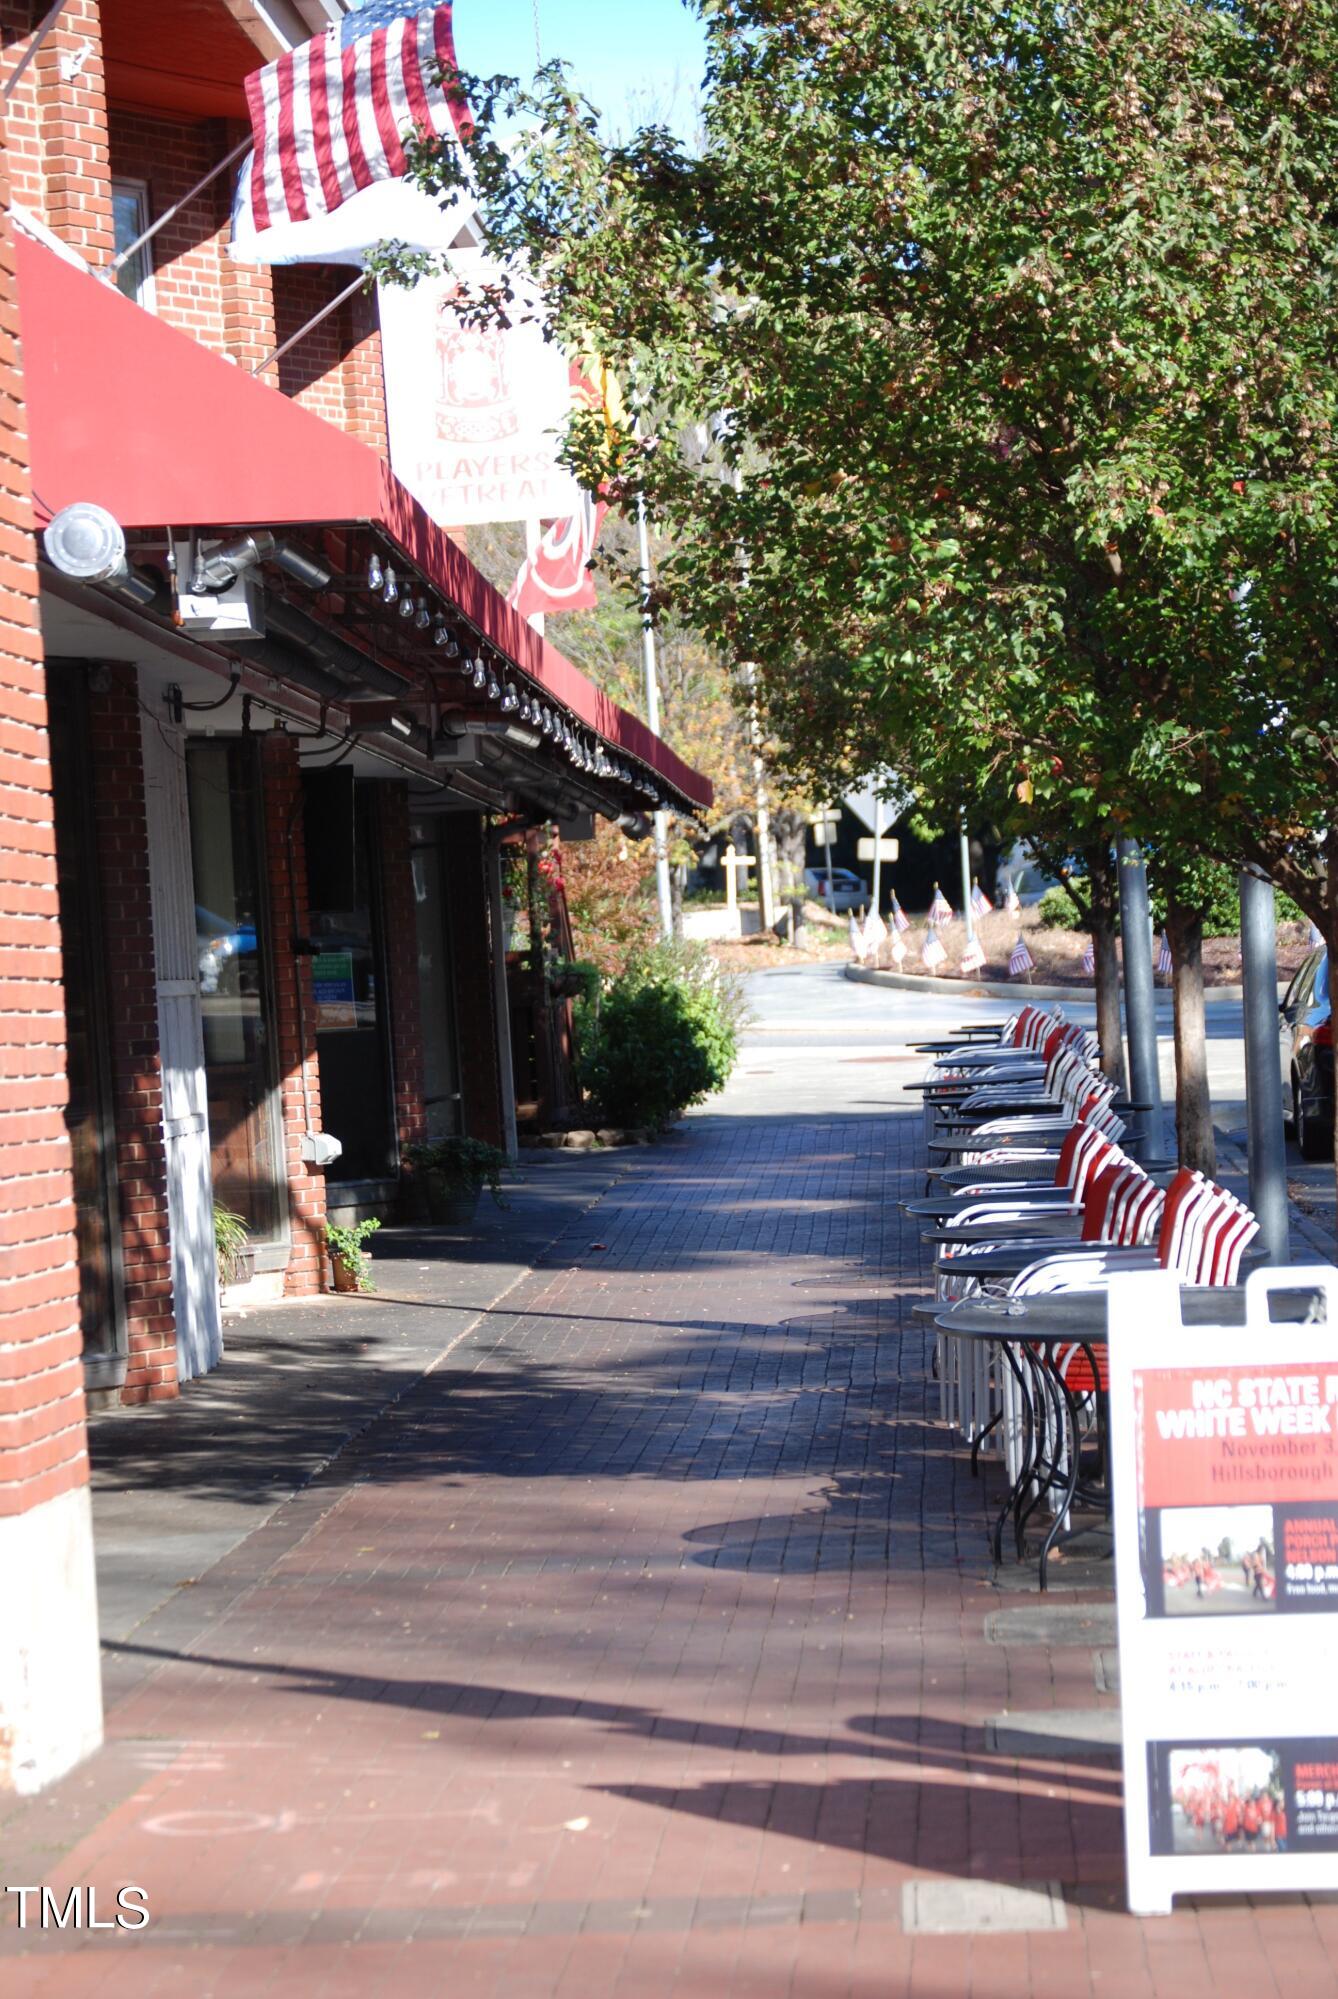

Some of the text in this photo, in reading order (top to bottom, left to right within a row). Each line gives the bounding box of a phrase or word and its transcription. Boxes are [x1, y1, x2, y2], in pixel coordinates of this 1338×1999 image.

[416, 452, 550, 481] PLAYERS
[1192, 1379, 1233, 1409] NC
[1238, 1376, 1320, 1407] STATE
[1156, 1404, 1332, 1440] WHITE WEEK
[1222, 1438, 1317, 1457] November
[1211, 1460, 1333, 1482] Hillsborough
